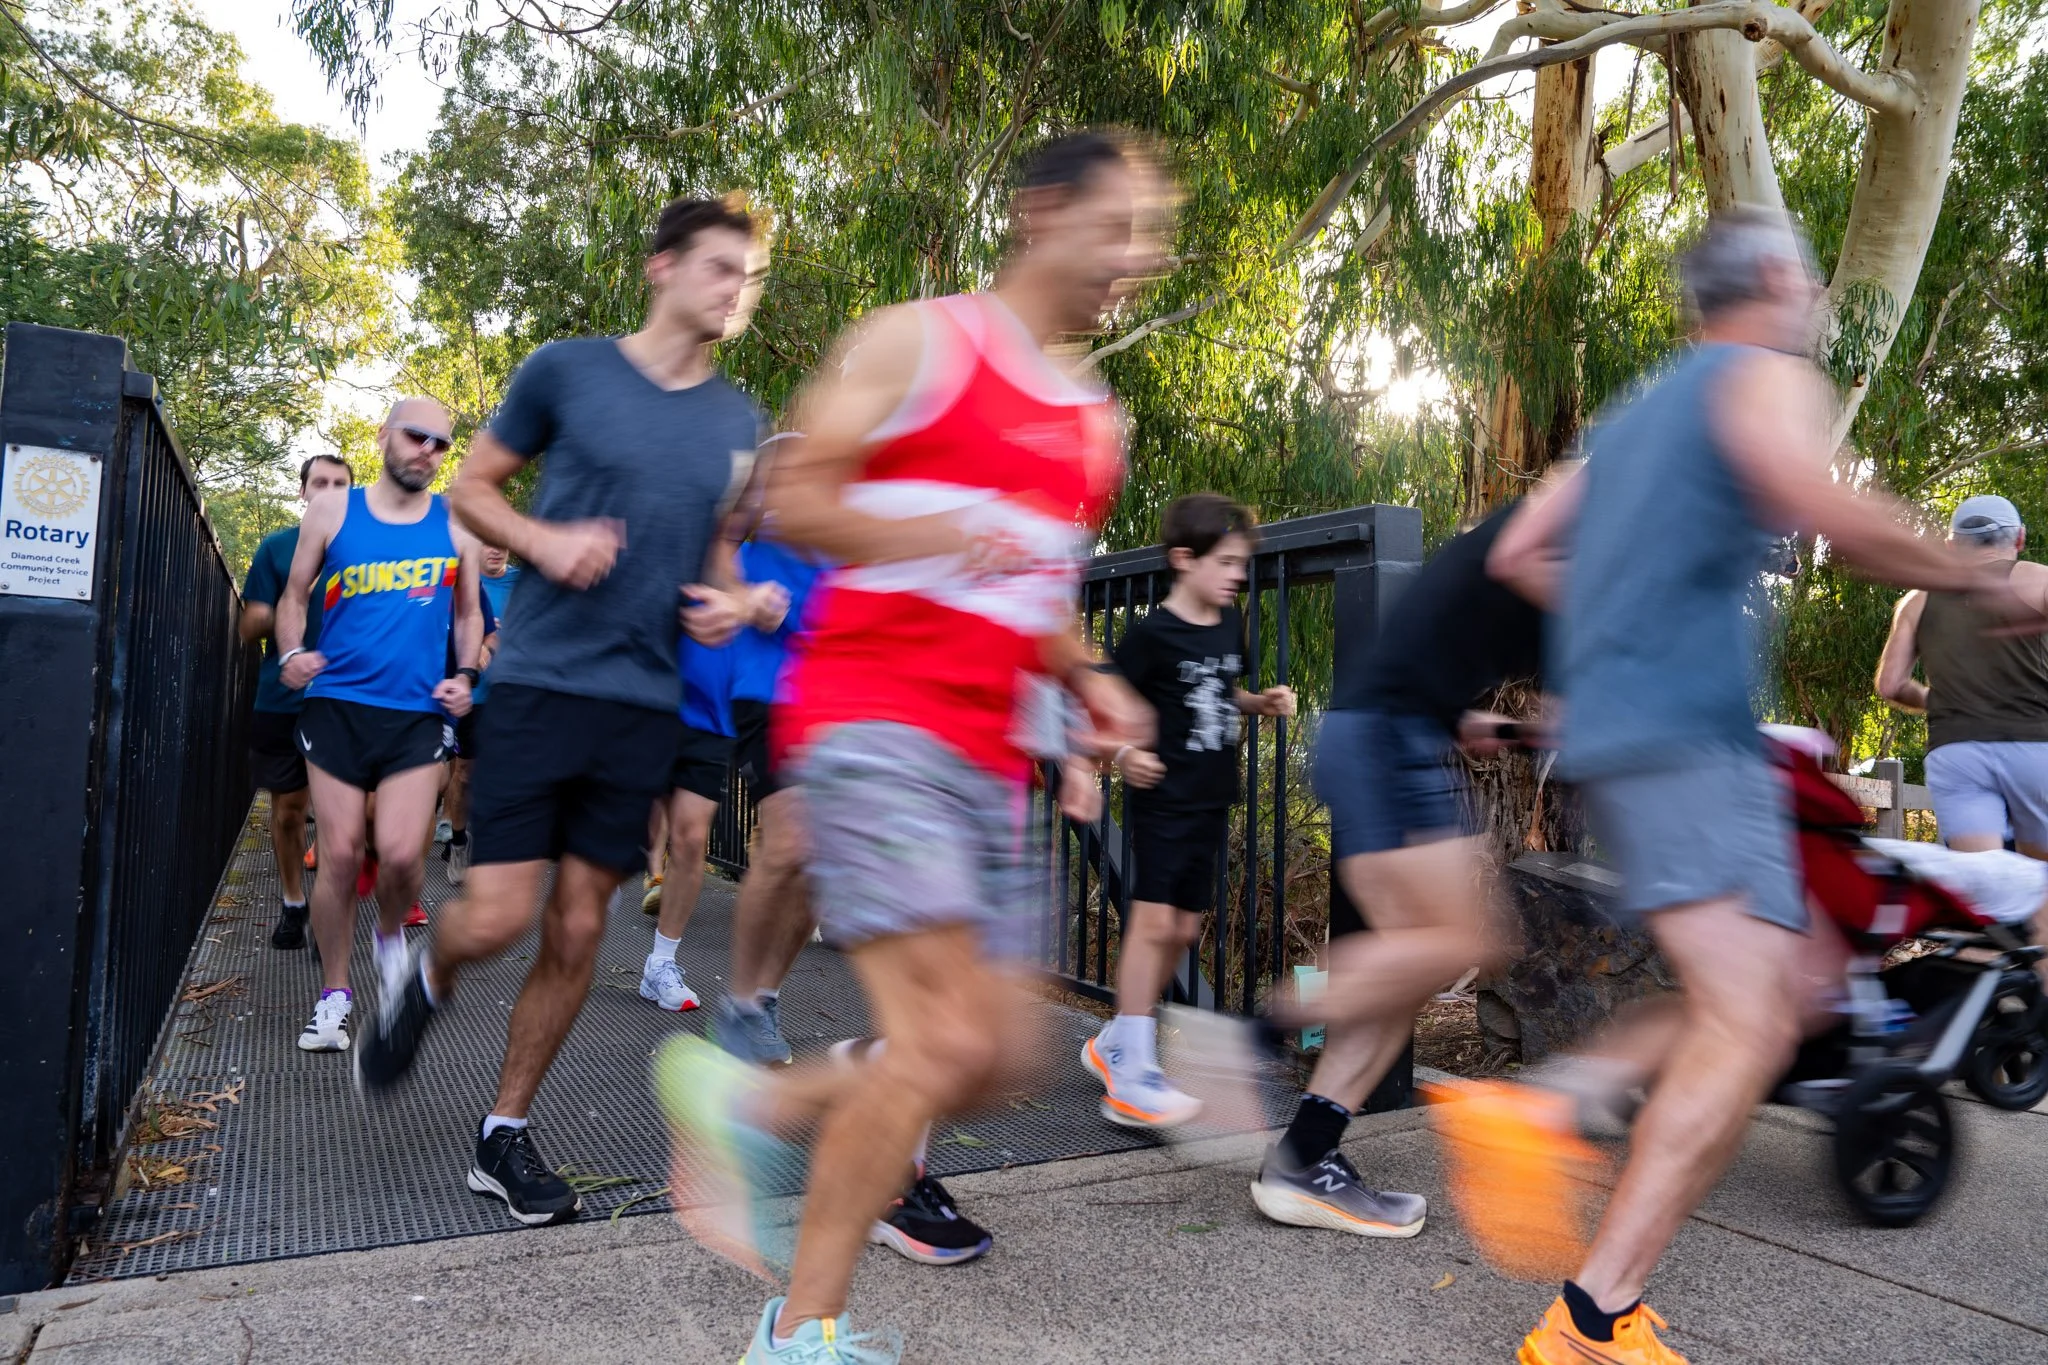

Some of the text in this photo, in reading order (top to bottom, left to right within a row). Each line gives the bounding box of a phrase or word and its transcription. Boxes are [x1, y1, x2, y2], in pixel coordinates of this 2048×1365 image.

[6, 519, 89, 549] Rotary
[11, 551, 80, 564] Diamond Creek
[0, 562, 89, 576] Community Service
[28, 575, 60, 585] Project
[342, 557, 442, 598] SUNSET
